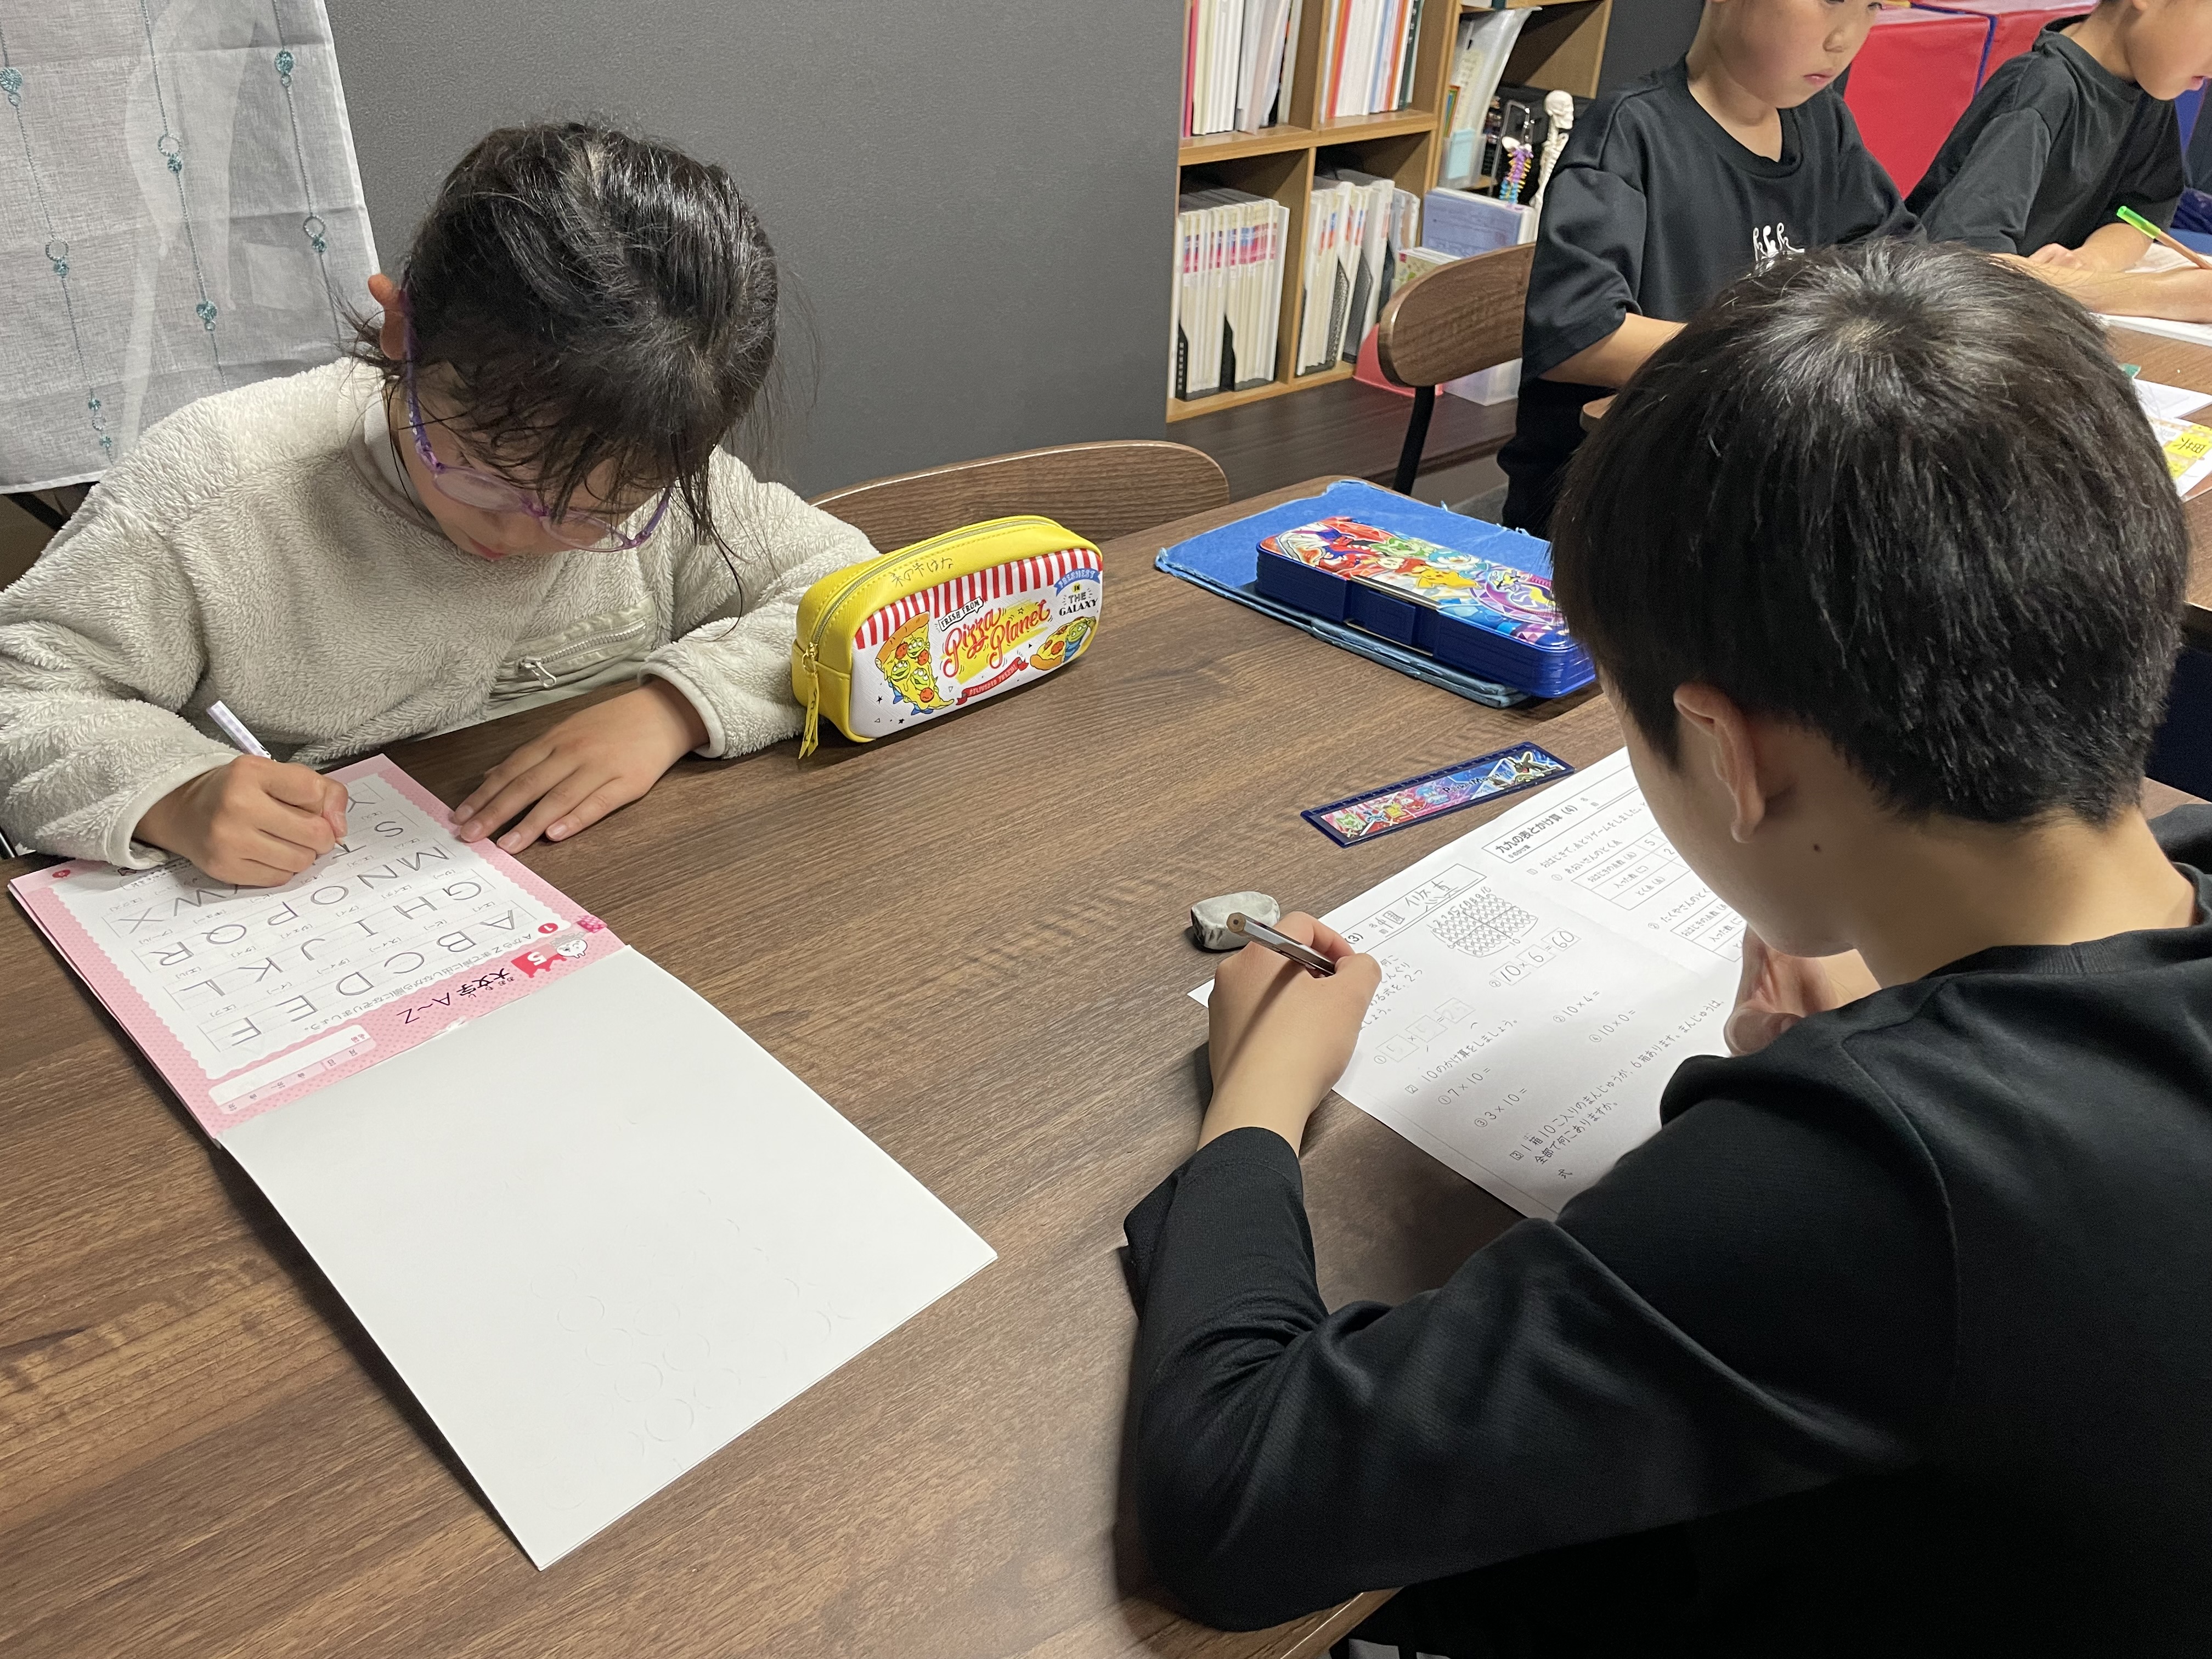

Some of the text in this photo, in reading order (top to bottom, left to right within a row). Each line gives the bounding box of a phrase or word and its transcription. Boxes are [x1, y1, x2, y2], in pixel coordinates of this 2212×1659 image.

[1059, 597, 1098, 616] GALAXY
[1068, 591, 1086, 604] THE
[940, 599, 980, 628] FRESH FROM
[943, 607, 1002, 678] Pizza
[989, 599, 1051, 669] Planet
[374, 821, 404, 837] S
[1495, 813, 1563, 854] 九九の表とかけ算
[149, 846, 450, 966] M N O P Q R
[173, 888, 227, 917] W
[117, 906, 165, 935] X
[179, 881, 482, 997] G H I J K L
[1344, 932, 1364, 944] (3)
[527, 951, 547, 967] 5
[1500, 964, 1521, 982] 10
[1528, 951, 1544, 963] 6
[1551, 930, 1575, 949] 60
[231, 910, 515, 1047] A B C D E F
[456, 968, 511, 996] 大文字
[1557, 1169, 1573, 1179] 式
